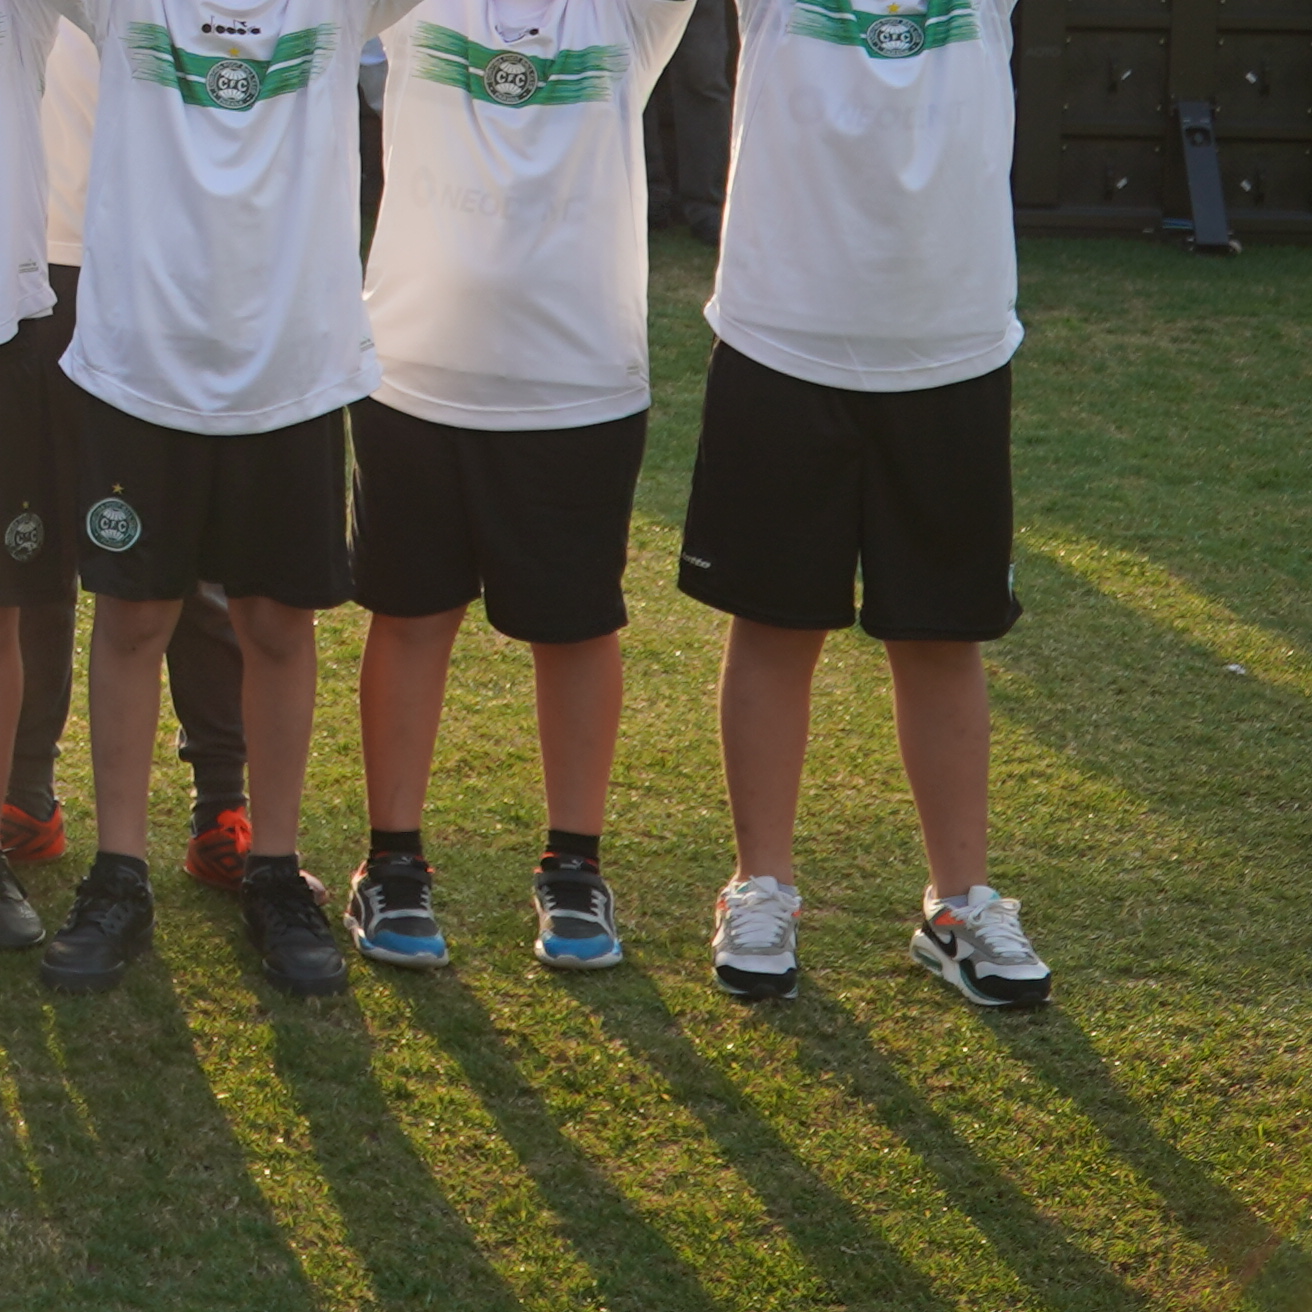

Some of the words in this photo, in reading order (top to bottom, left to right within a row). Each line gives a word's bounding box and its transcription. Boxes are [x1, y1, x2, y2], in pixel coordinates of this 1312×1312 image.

[202, 15, 262, 35] diadora
[218, 77, 248, 92] CFC
[496, 71, 526, 87] CFC
